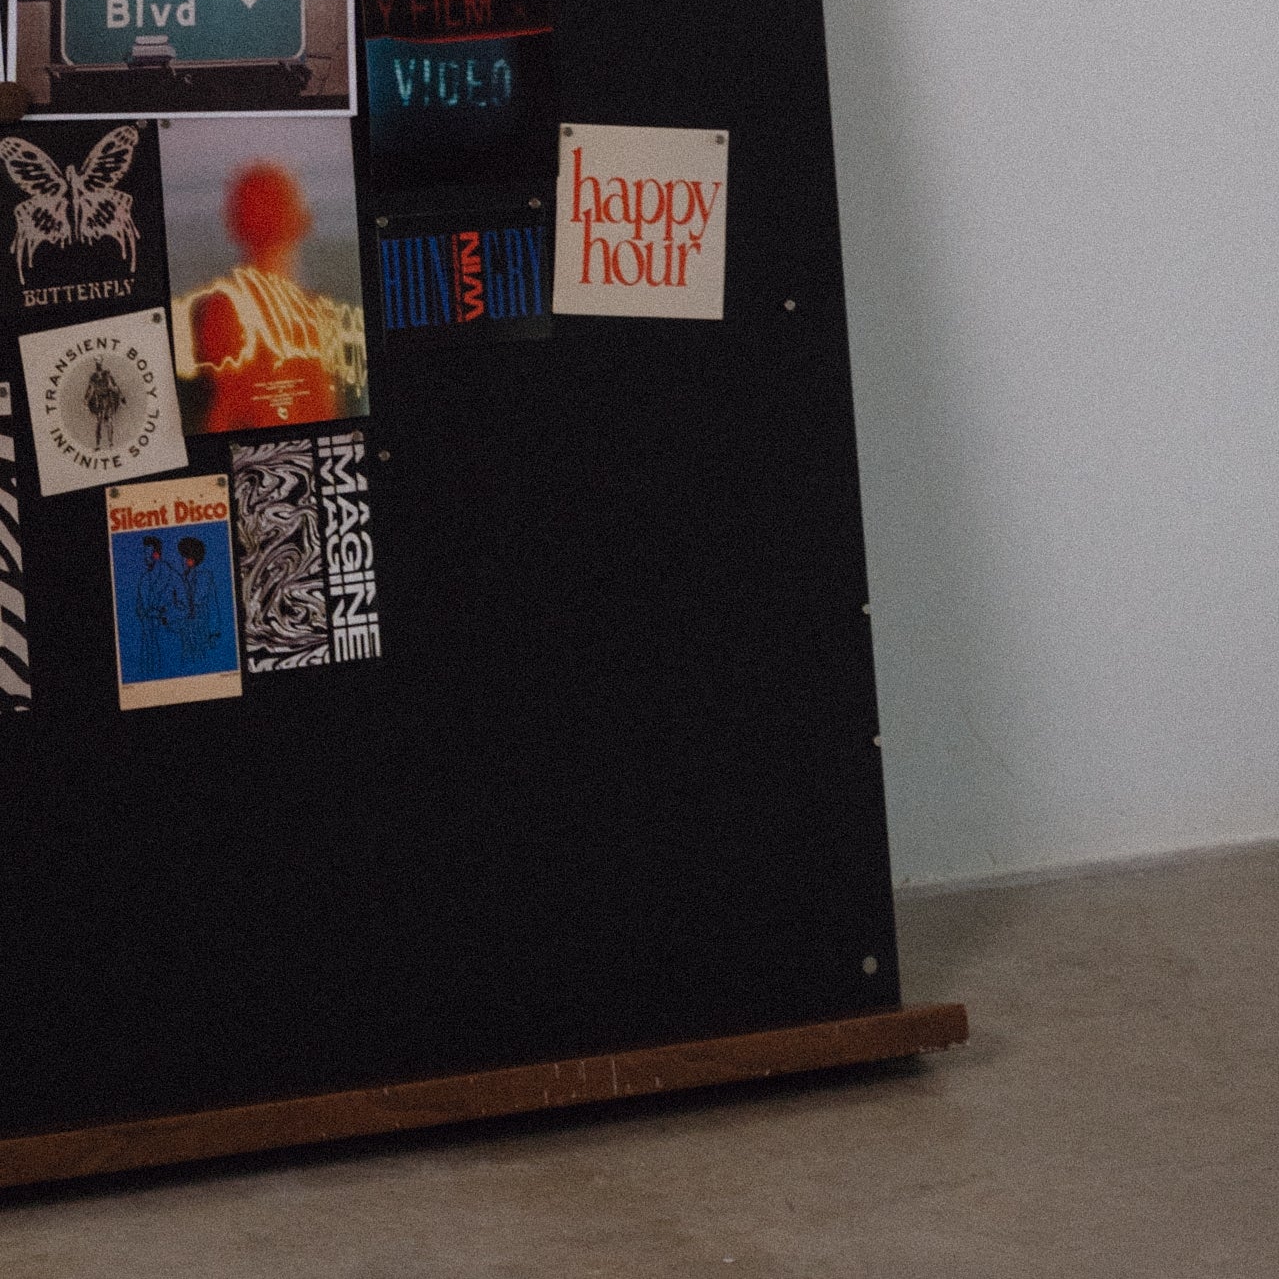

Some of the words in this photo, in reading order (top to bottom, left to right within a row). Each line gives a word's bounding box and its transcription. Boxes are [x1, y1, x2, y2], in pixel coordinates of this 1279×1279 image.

[393, 58, 512, 107] VIDEO
[571, 146, 723, 242] happy
[579, 208, 702, 287] hour
[23, 279, 135, 307] BUTTERFLY
[45, 337, 120, 415] TRANSIENT
[126, 347, 158, 399] BODY
[50, 427, 122, 470] INFINITE
[128, 408, 160, 458] SOUL
[109, 507, 168, 532] Silent
[174, 498, 228, 524] Disco
[317, 433, 382, 663] IMAGINE
